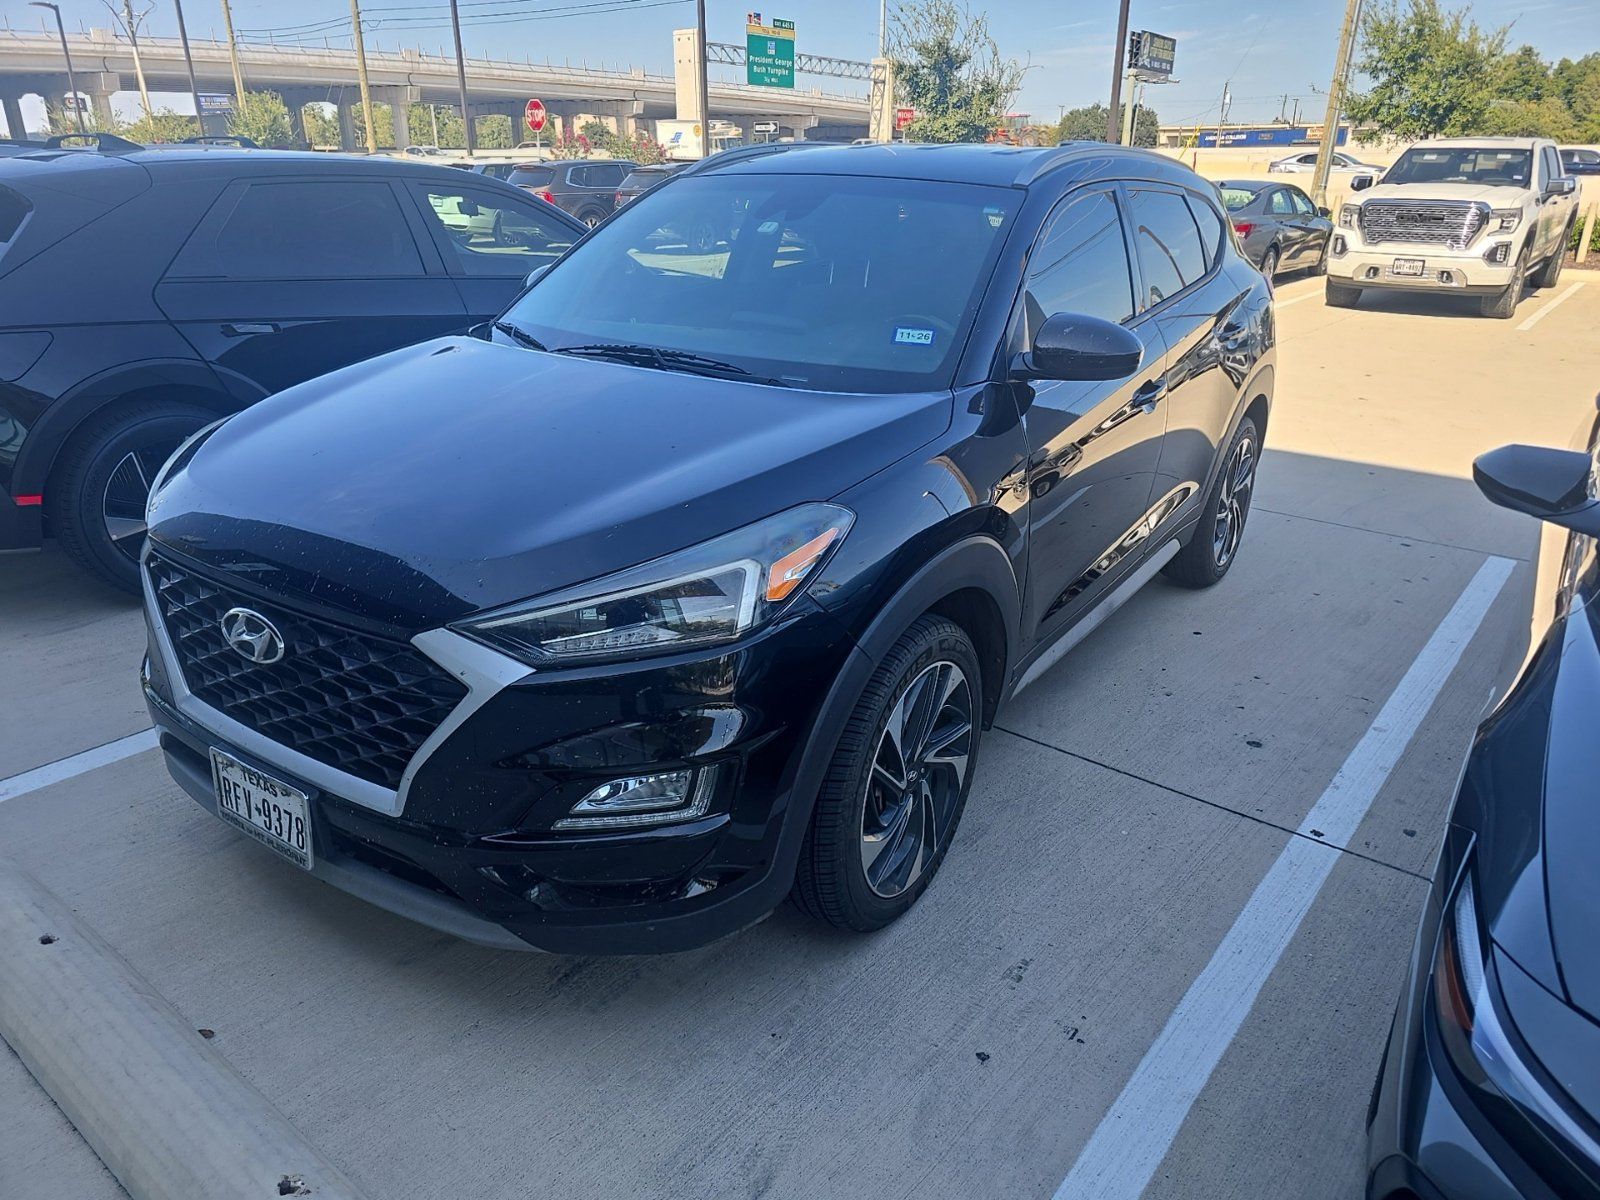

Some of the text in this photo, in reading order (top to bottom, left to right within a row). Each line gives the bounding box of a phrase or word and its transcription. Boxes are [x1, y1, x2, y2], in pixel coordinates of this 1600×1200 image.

[749, 55, 792, 67] President George
[753, 65, 789, 76] Bush Turnpike
[527, 109, 545, 122] STOP
[241, 766, 278, 798] TEXAS
